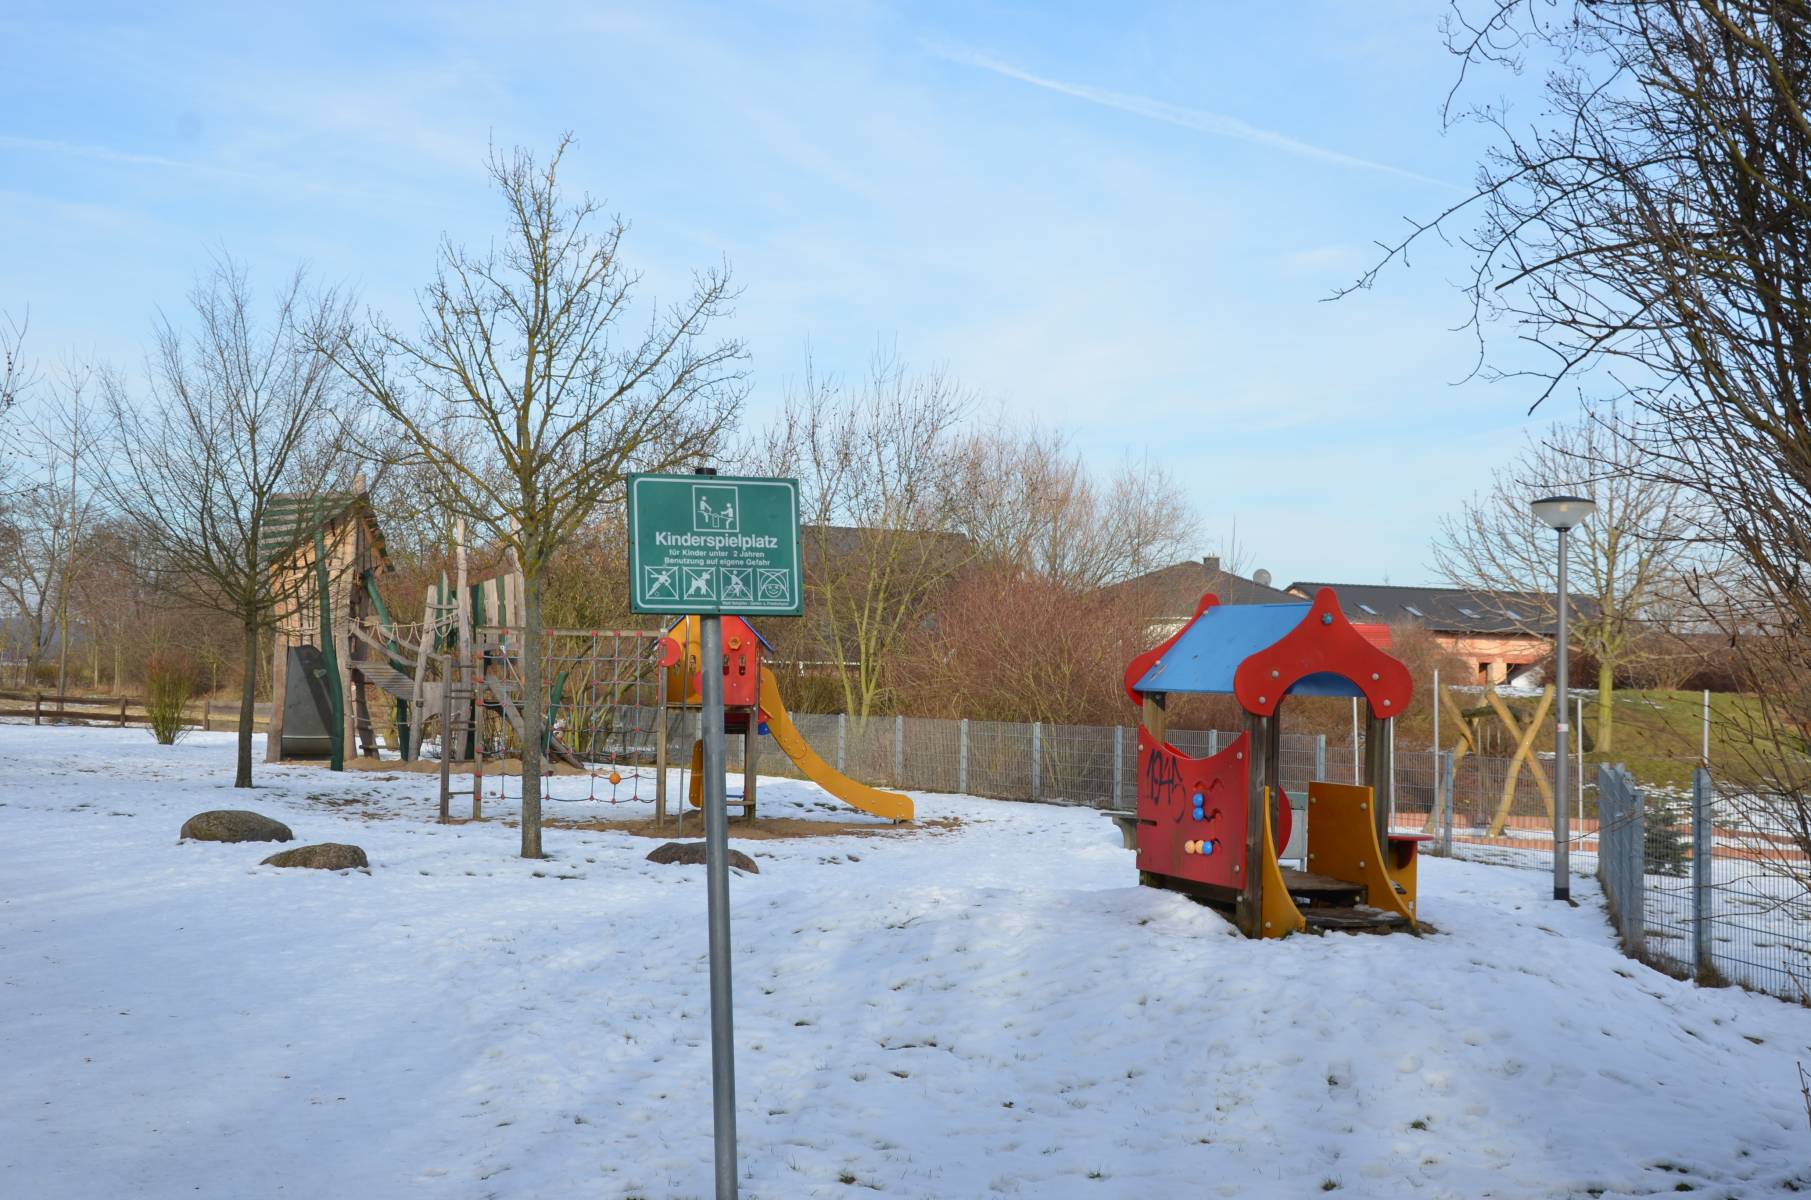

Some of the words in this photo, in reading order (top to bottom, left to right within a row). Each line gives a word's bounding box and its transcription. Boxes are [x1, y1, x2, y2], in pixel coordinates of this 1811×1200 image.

[655, 531, 778, 550] Kinderspielplatz
[682, 549, 707, 557] Kinder
[739, 550, 765, 558] Jahren
[664, 557, 704, 566] Benutzung
[706, 557, 718, 565] auf
[719, 558, 743, 567] eigene
[745, 558, 770, 566] Gefahr
